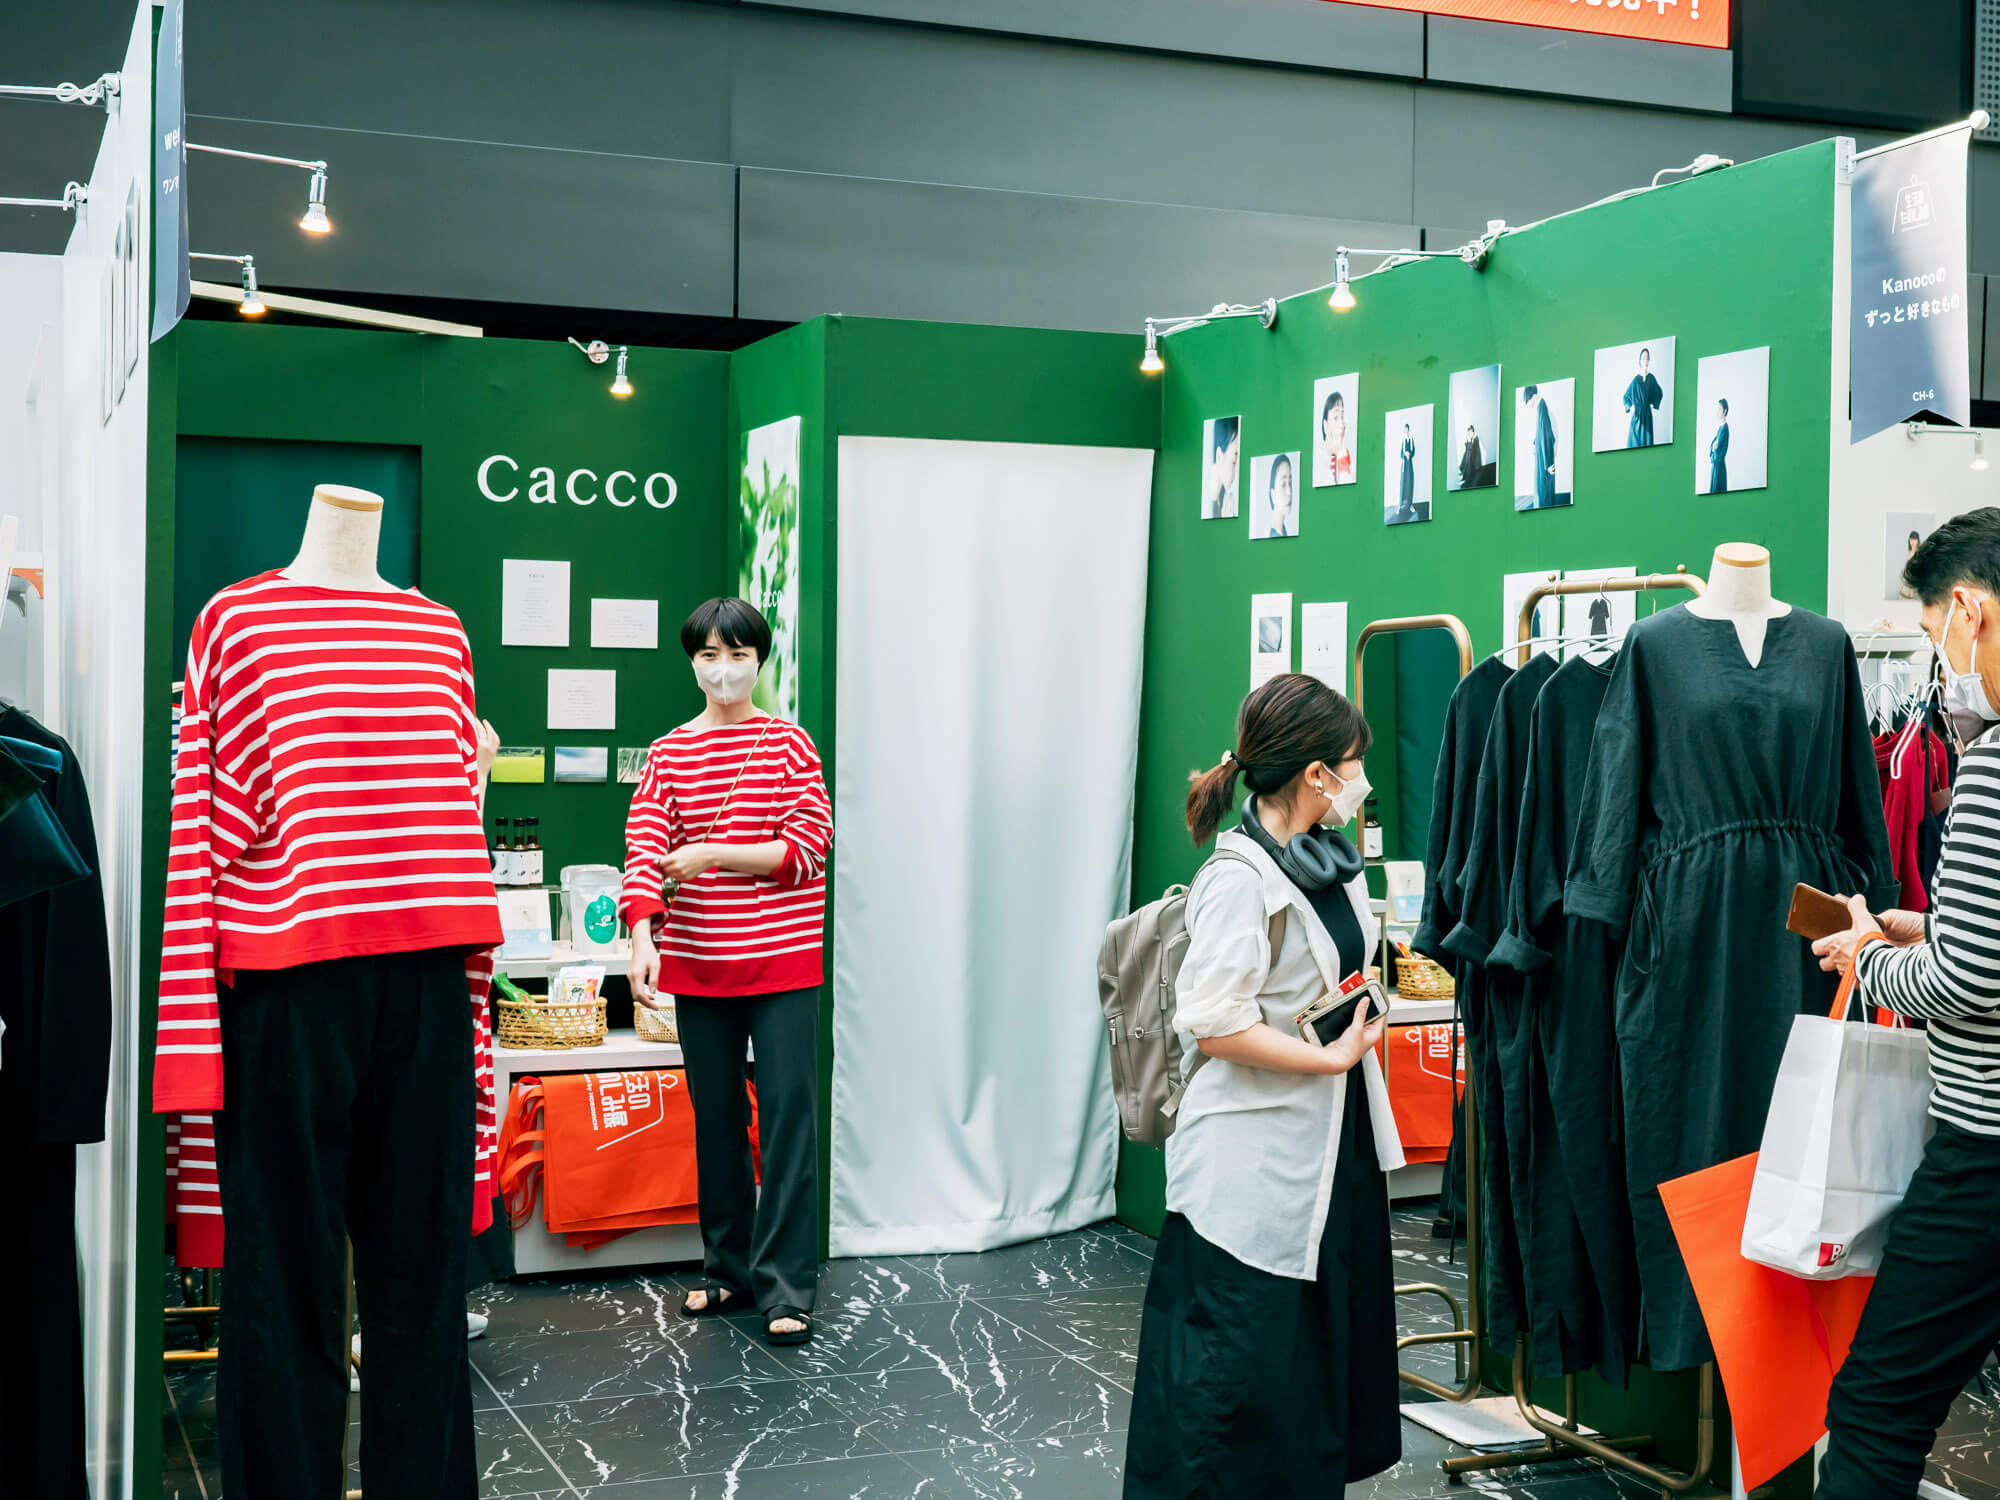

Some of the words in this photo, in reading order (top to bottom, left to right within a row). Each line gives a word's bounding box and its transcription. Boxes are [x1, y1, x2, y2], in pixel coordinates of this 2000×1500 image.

[1864, 292, 1960, 328] ずっと好きなもの
[1912, 388, 1934, 402] CH-6
[477, 454, 678, 509] Cacco
[759, 590, 784, 609] acco
